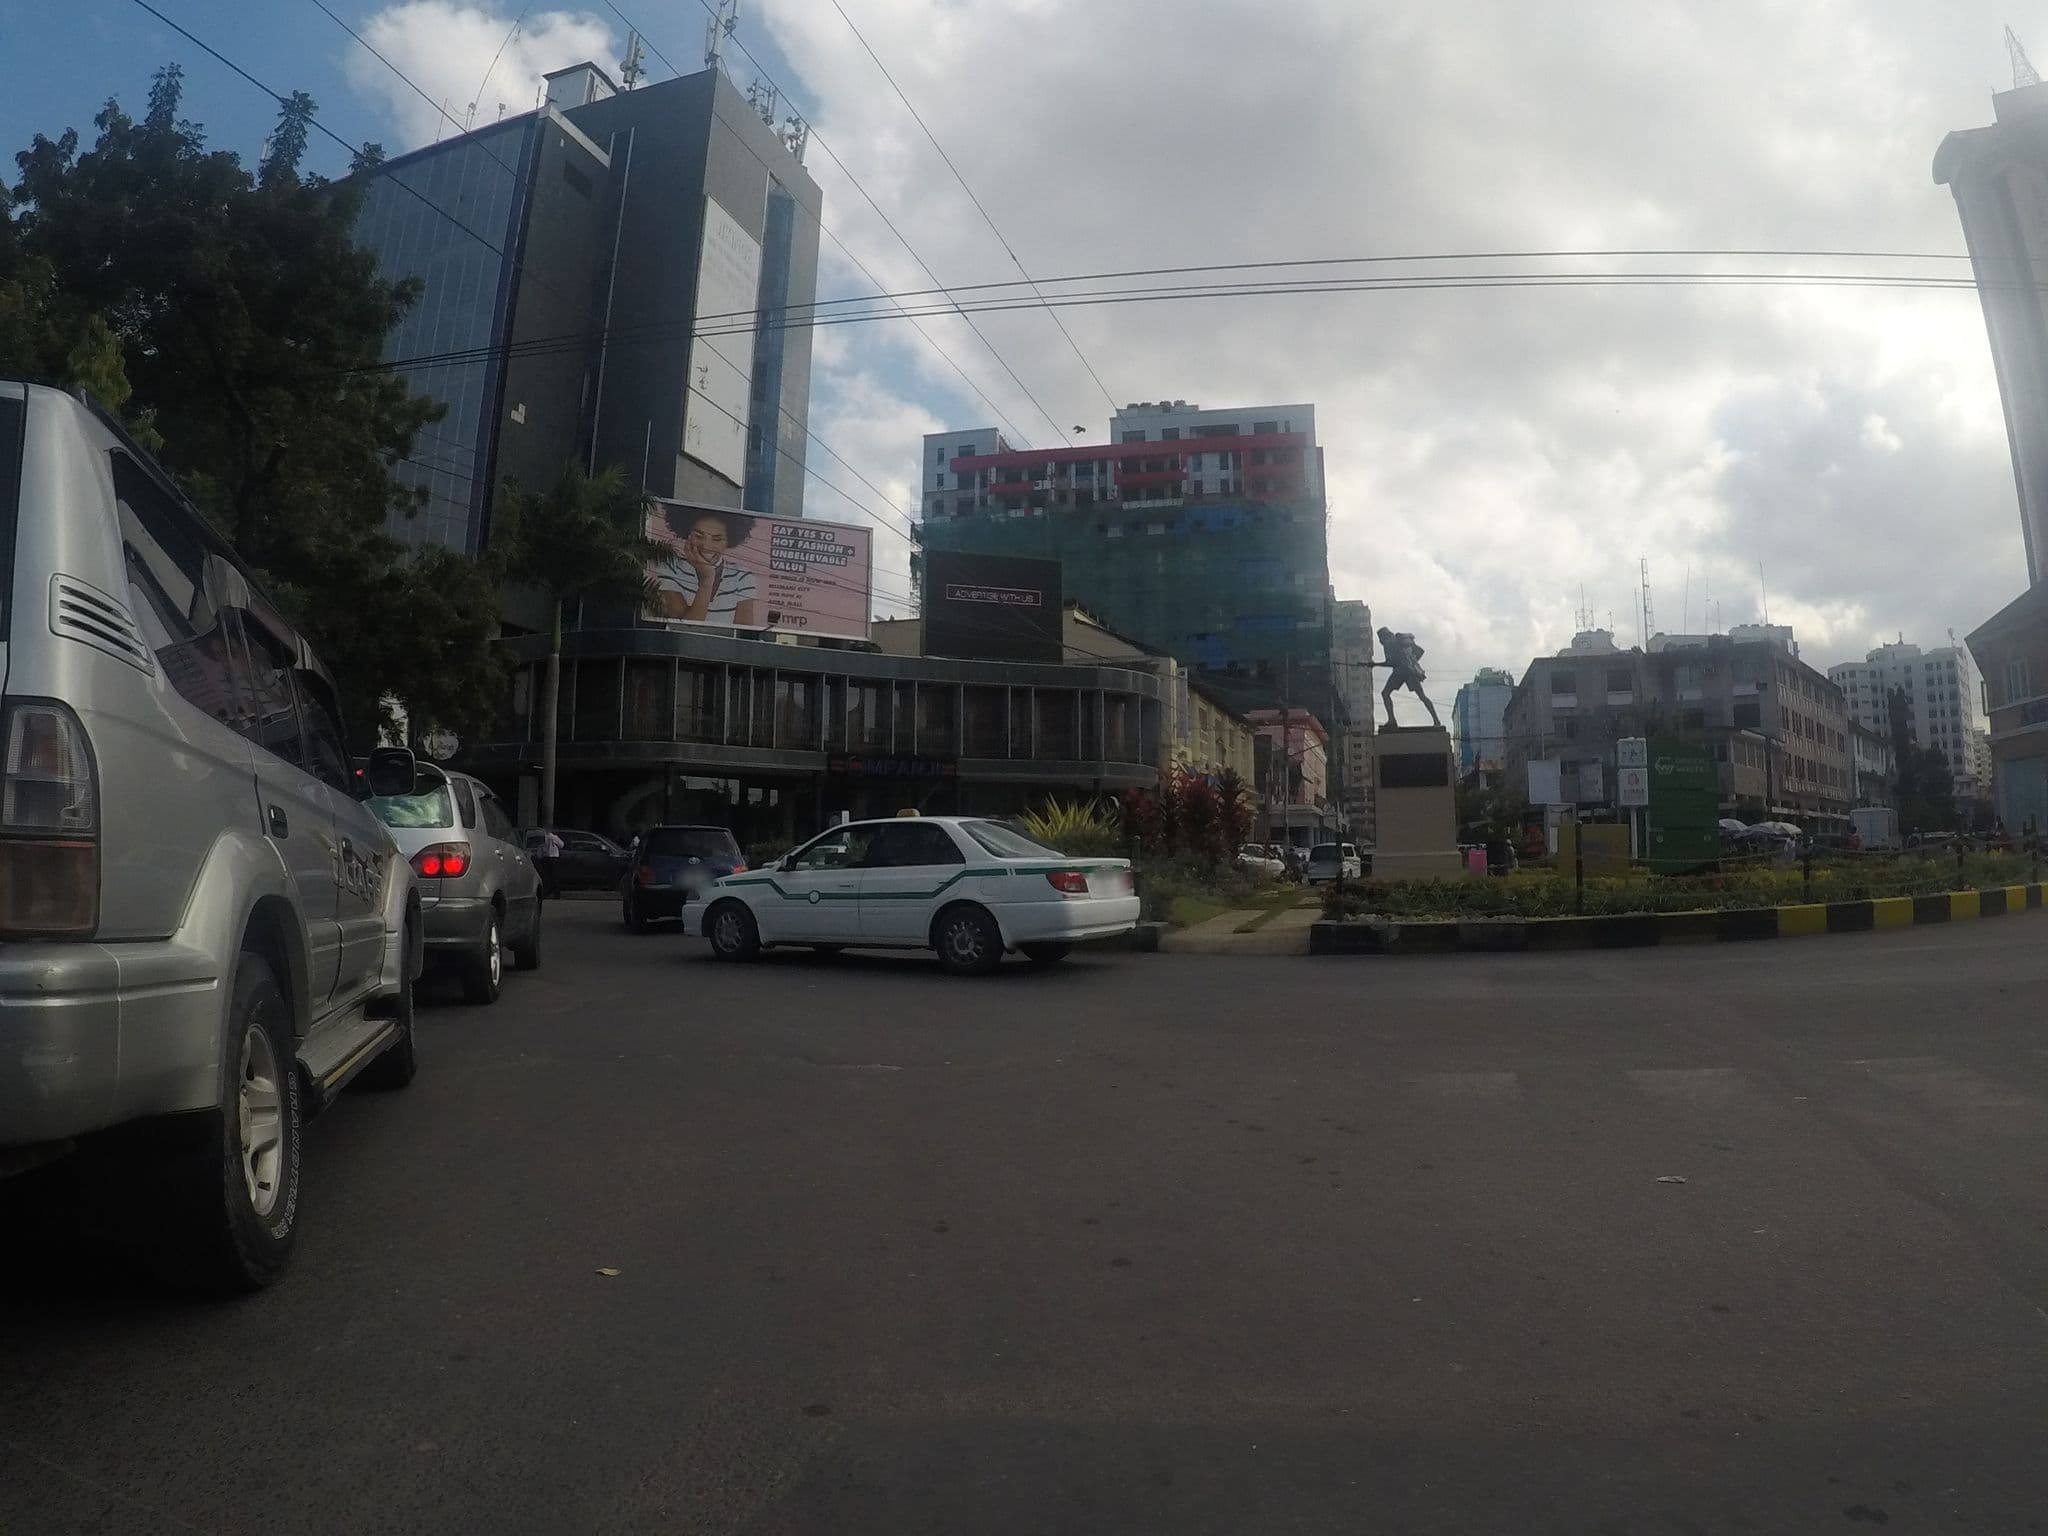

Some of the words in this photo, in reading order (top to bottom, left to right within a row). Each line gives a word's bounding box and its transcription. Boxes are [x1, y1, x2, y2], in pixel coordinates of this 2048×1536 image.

[772, 525, 794, 536] SAY
[798, 529, 817, 538] YES
[819, 532, 834, 541] TO
[772, 538, 795, 548] HOT
[797, 541, 844, 554] FASHION
[771, 549, 847, 566] UNBELIEVABLE
[771, 561, 805, 573] VALUE
[955, 590, 999, 601] ADVERTISE
[1000, 592, 1021, 602] WITH
[1021, 594, 1034, 603] US
[782, 614, 808, 627] mrp
